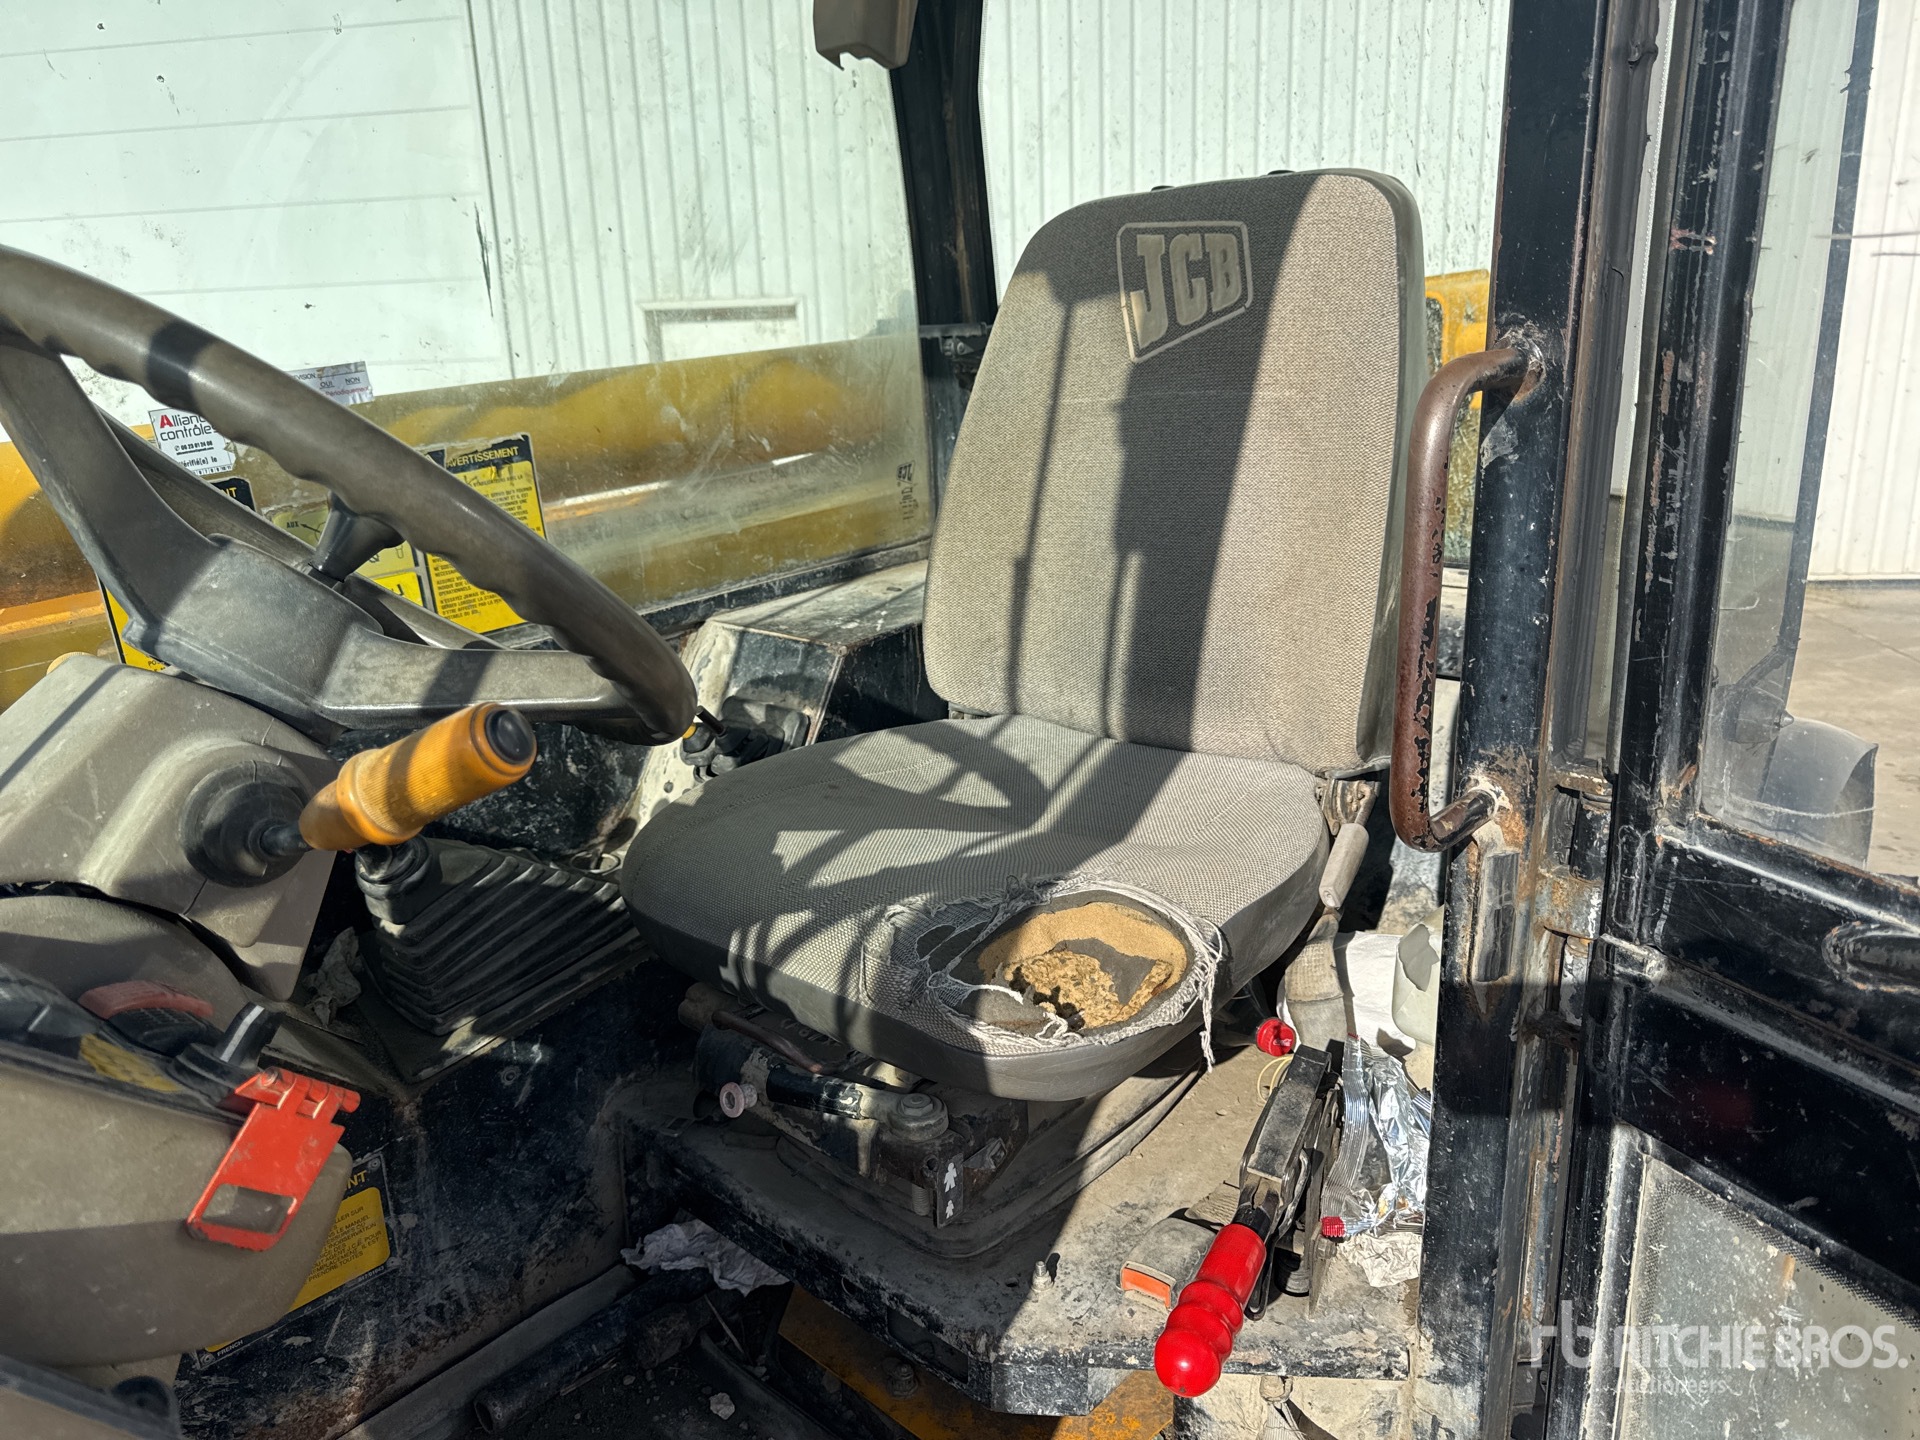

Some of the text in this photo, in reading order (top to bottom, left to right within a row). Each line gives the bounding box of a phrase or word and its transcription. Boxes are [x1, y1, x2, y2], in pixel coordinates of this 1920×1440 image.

[1130, 233, 1242, 350] JCB
[345, 376, 361, 384] NON
[160, 414, 207, 428] Allianc
[446, 446, 519, 467] AVERTISSEMENT
[286, 521, 299, 529] AUX
